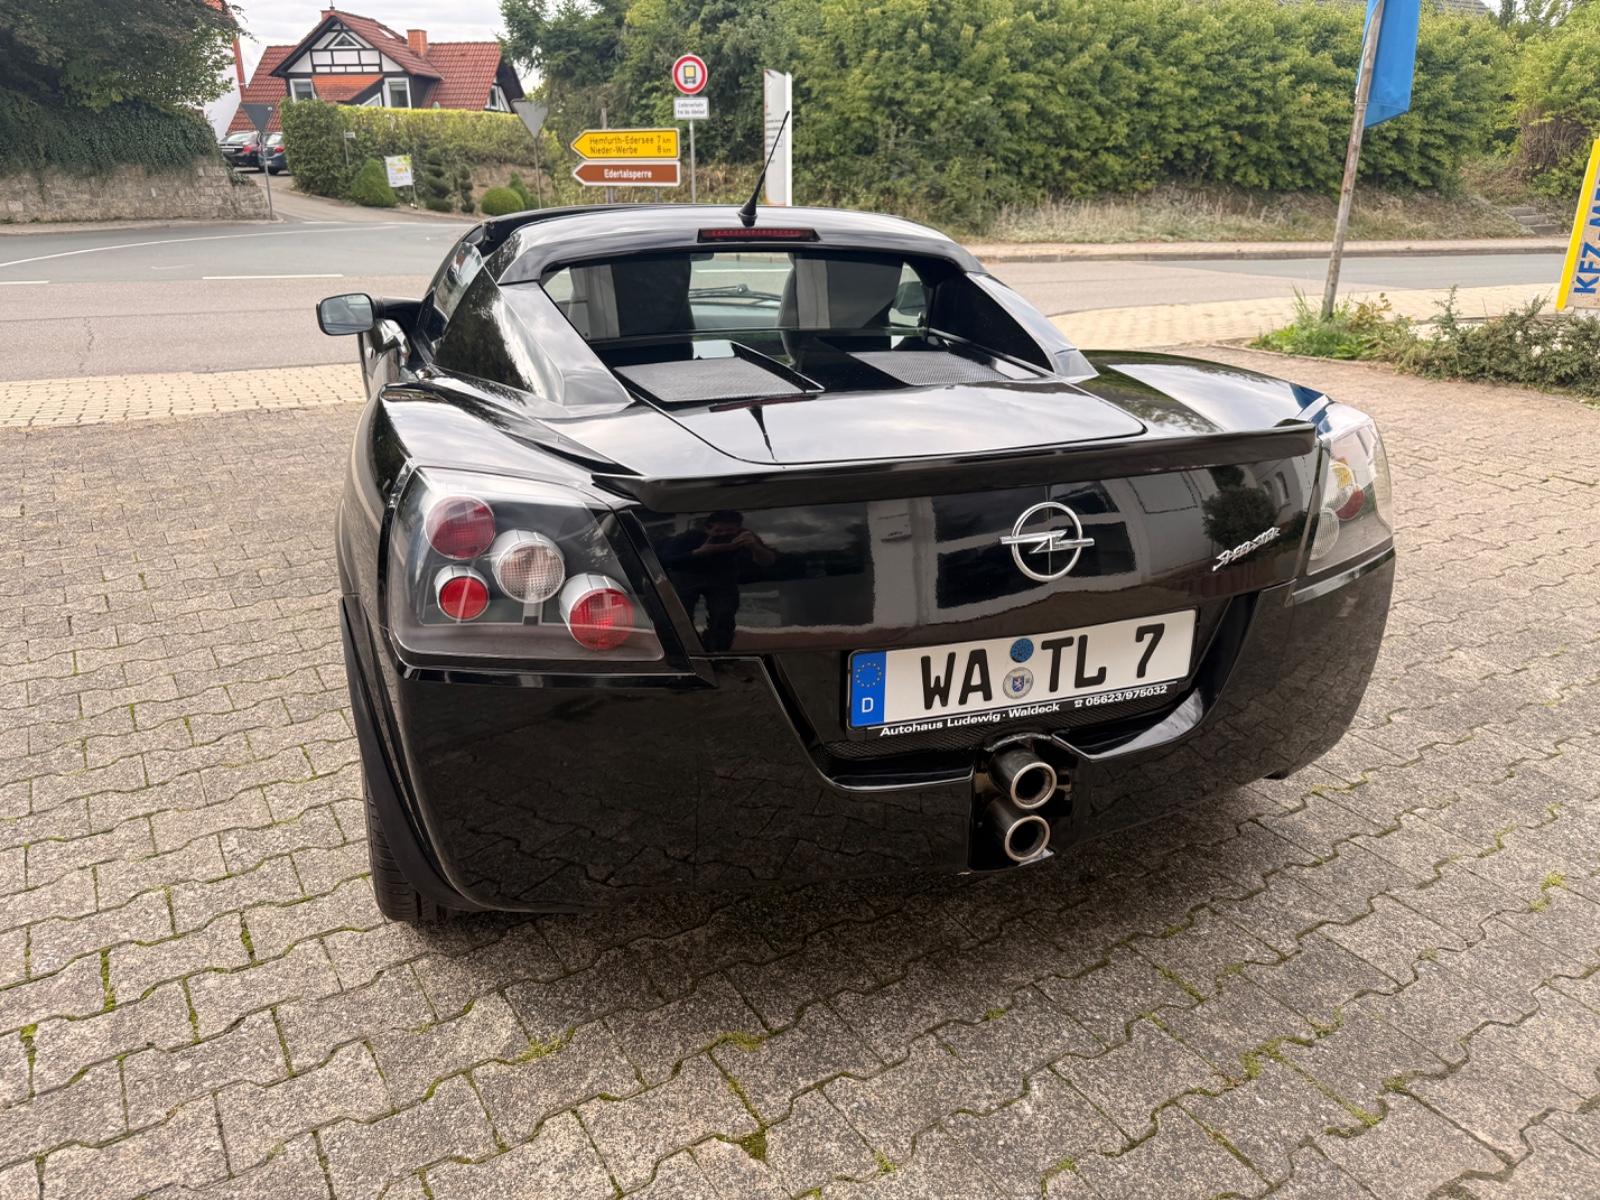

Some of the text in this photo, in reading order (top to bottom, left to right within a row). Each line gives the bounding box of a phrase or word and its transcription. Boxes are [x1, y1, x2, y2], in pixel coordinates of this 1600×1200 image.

[589, 135, 672, 145] Hemfurth-Edersee 7 km
[589, 145, 638, 154] Nieder-Werbe
[603, 168, 653, 180] Edertalsperre
[920, 622, 1165, 710] WA TL 7
[861, 697, 874, 713] D
[880, 685, 1168, 737] Autohaus Ludewig Waldeck 05623/975032
